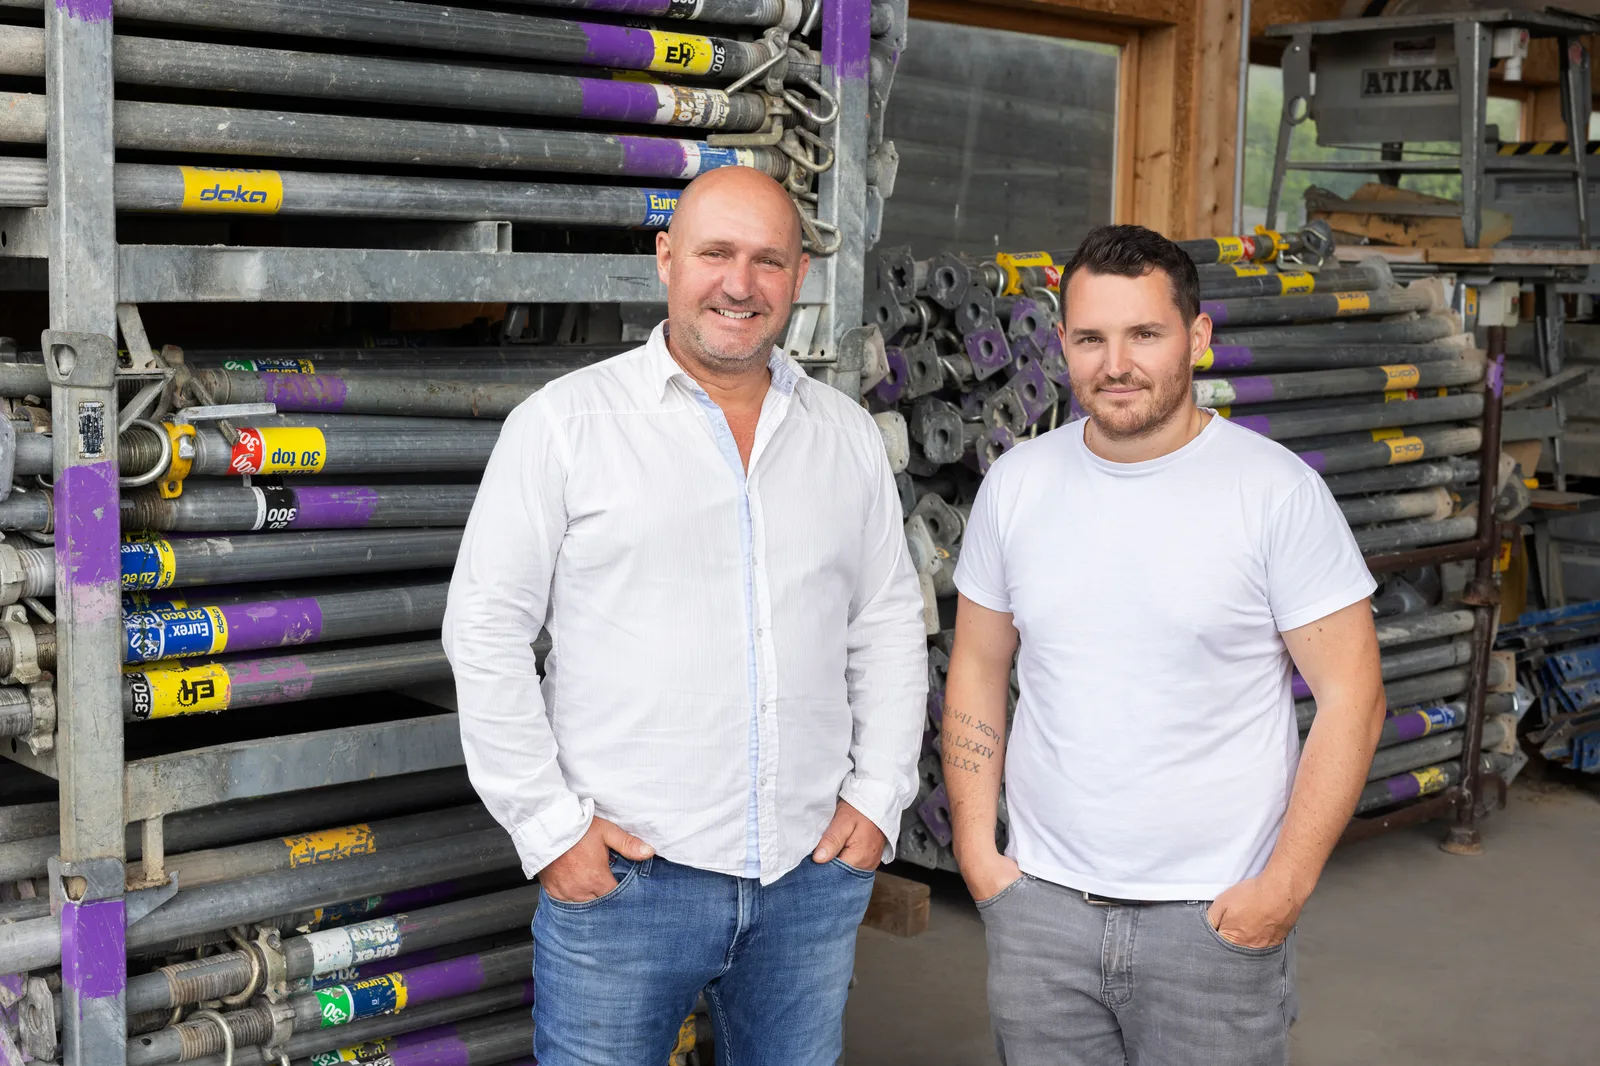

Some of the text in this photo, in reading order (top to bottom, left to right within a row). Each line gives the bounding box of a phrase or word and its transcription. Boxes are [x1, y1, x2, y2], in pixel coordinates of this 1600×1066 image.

[712, 45, 726, 72] 300
[1364, 68, 1453, 94] ATIKA
[200, 184, 267, 203] doka
[649, 195, 677, 210] Eure
[645, 213, 665, 226] 20
[271, 448, 321, 467] 30 top
[267, 508, 297, 522] 300
[122, 573, 138, 584] ec
[140, 572, 156, 584] 20
[162, 610, 205, 621] 20 eco
[212, 609, 225, 634] doka
[172, 622, 209, 637] Eurex
[133, 683, 150, 713] 350
[352, 942, 400, 963] Eurex
[355, 976, 389, 990] Eurex
[323, 1002, 350, 1025] 250
